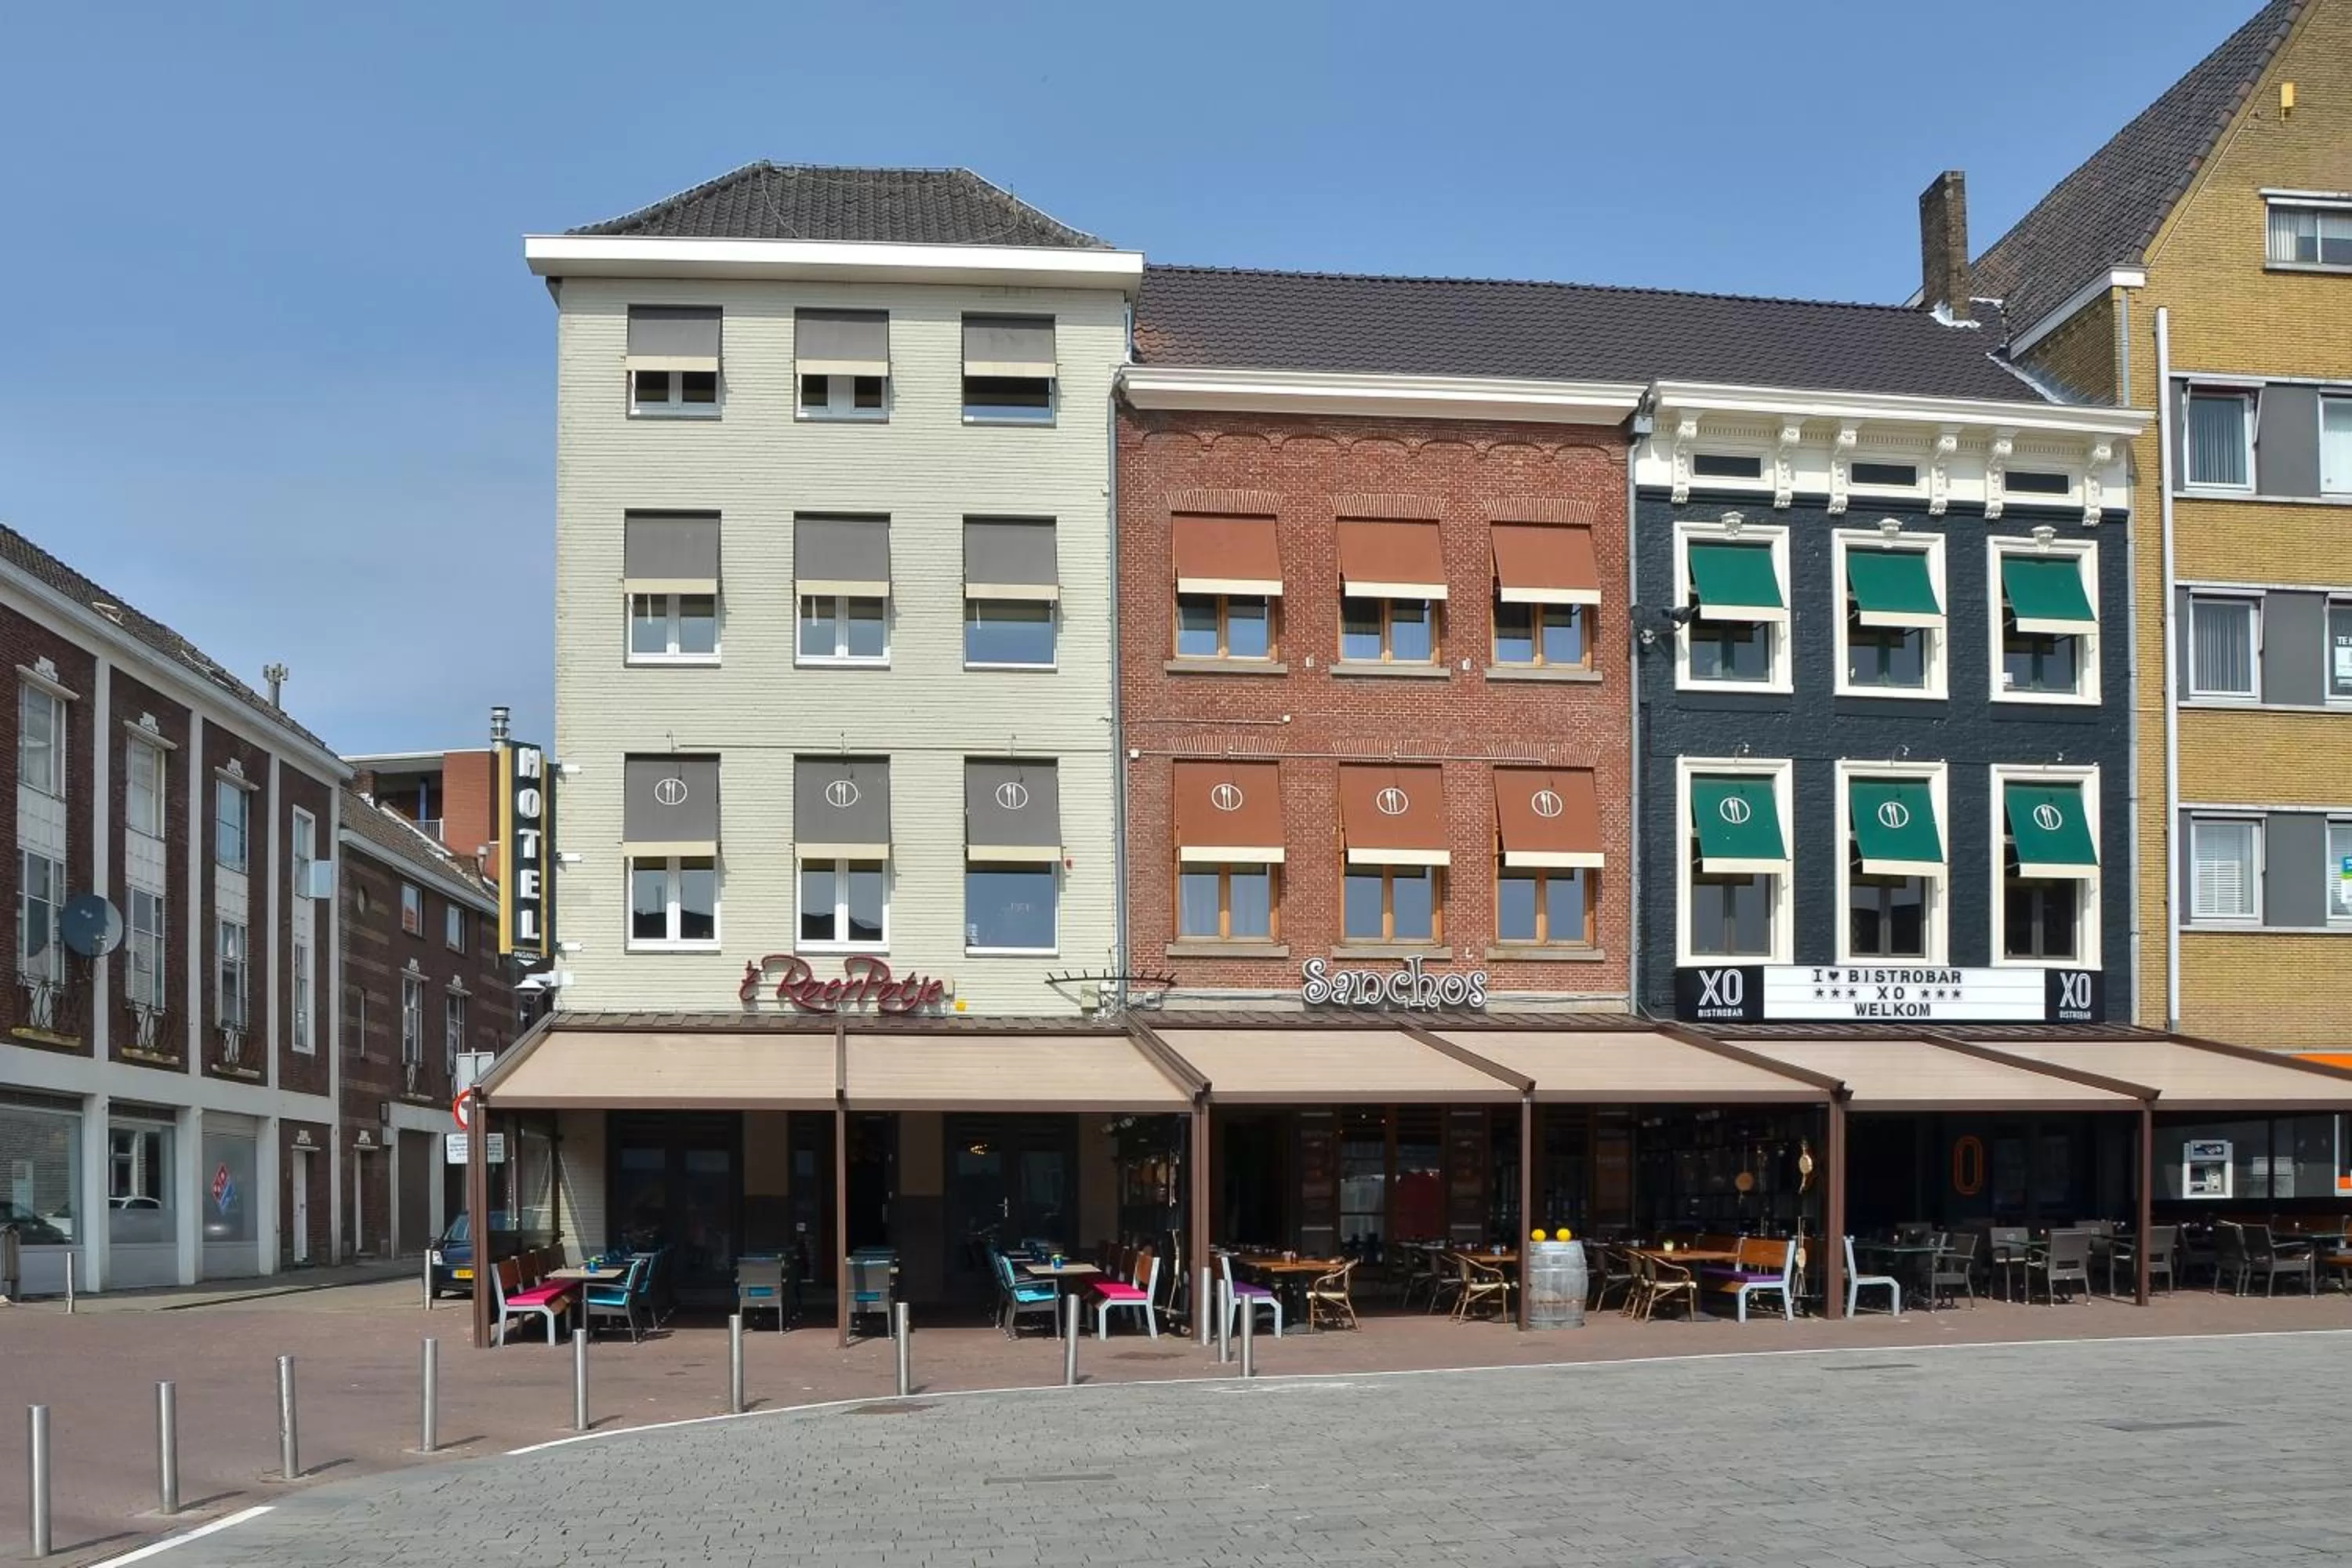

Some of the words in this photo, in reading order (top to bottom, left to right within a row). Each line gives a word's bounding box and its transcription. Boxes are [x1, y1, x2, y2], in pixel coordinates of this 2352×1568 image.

[517, 747, 540, 940] HOTEL
[1302, 955, 1487, 1008] Sanchos
[1697, 968, 1743, 1006] XO
[1813, 969, 1823, 982] I
[1849, 969, 1962, 984] BISTROBAR
[1877, 985, 1905, 1000] XO
[2060, 972, 2091, 1009] XO
[1854, 1003, 1931, 1017] WELKOM
